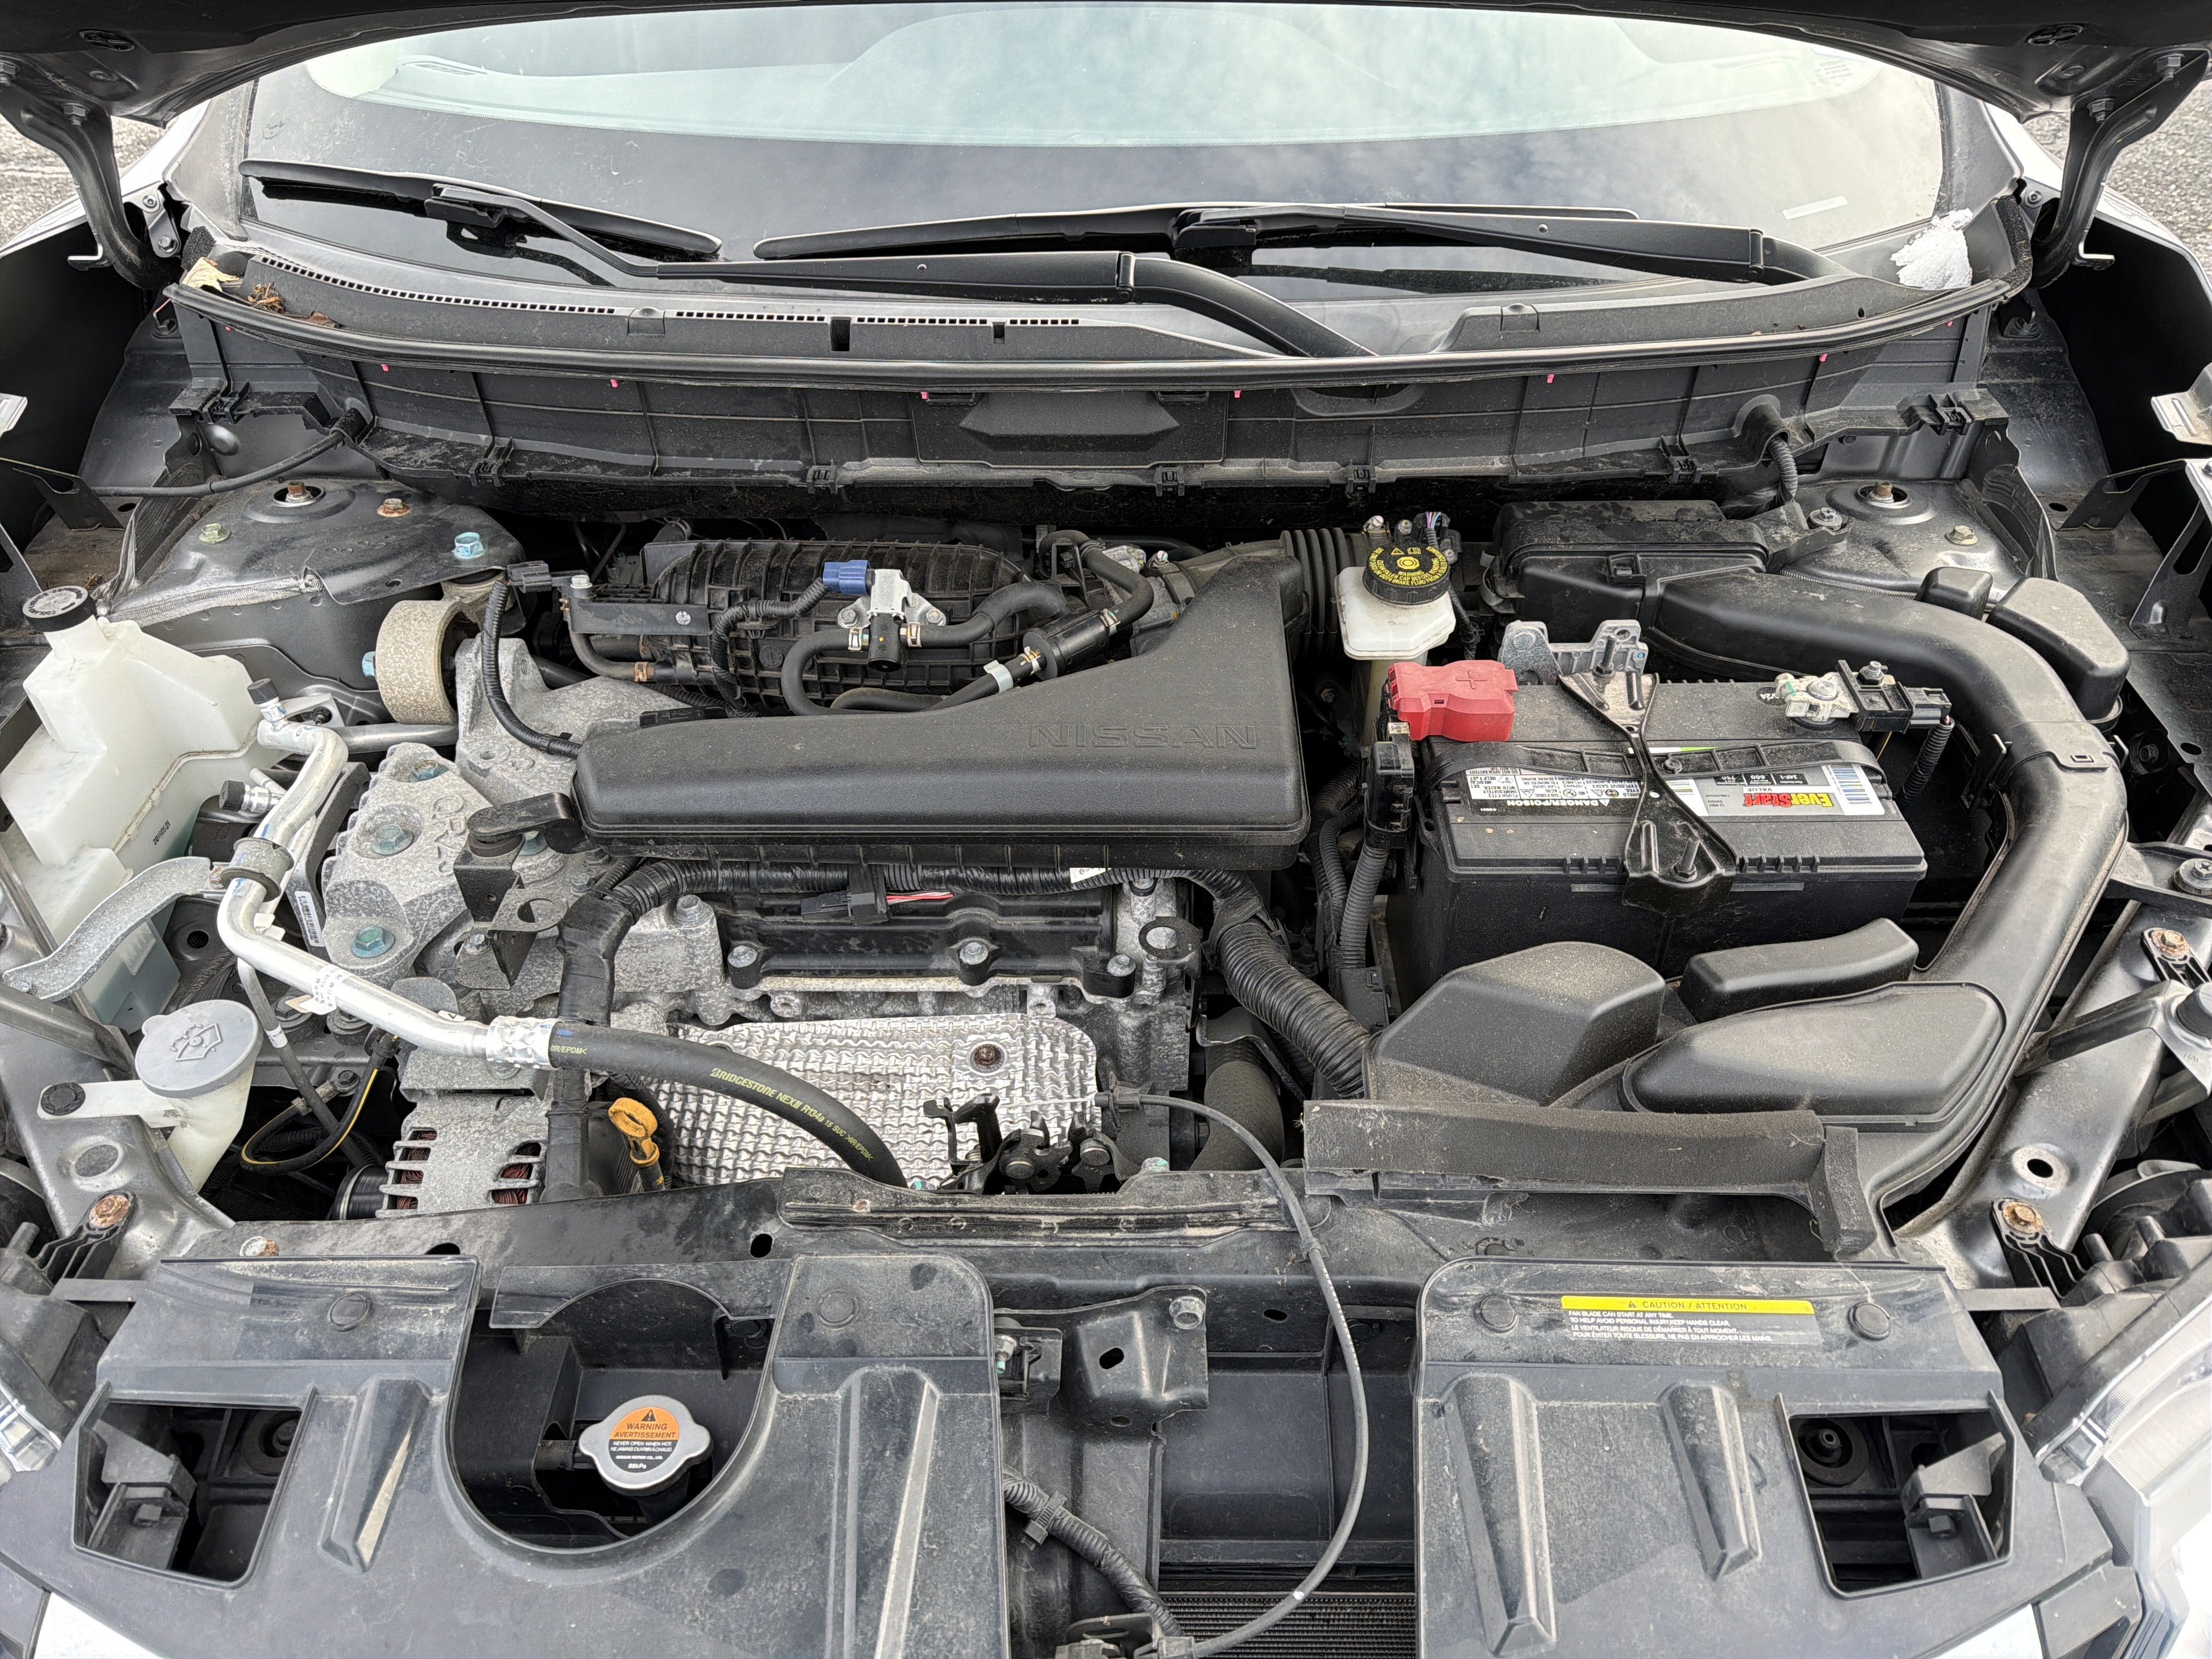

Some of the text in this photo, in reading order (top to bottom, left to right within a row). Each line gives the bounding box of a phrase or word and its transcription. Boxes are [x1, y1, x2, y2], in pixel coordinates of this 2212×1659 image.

[1412, 572, 1433, 581] BEFORE
[1029, 724, 1256, 749] NISSAN
[1743, 793, 1834, 808] EverStart
[709, 1068, 777, 1097] BRIDGESTONE
[800, 1104, 825, 1123] R134a
[832, 1125, 847, 1137] SUC
